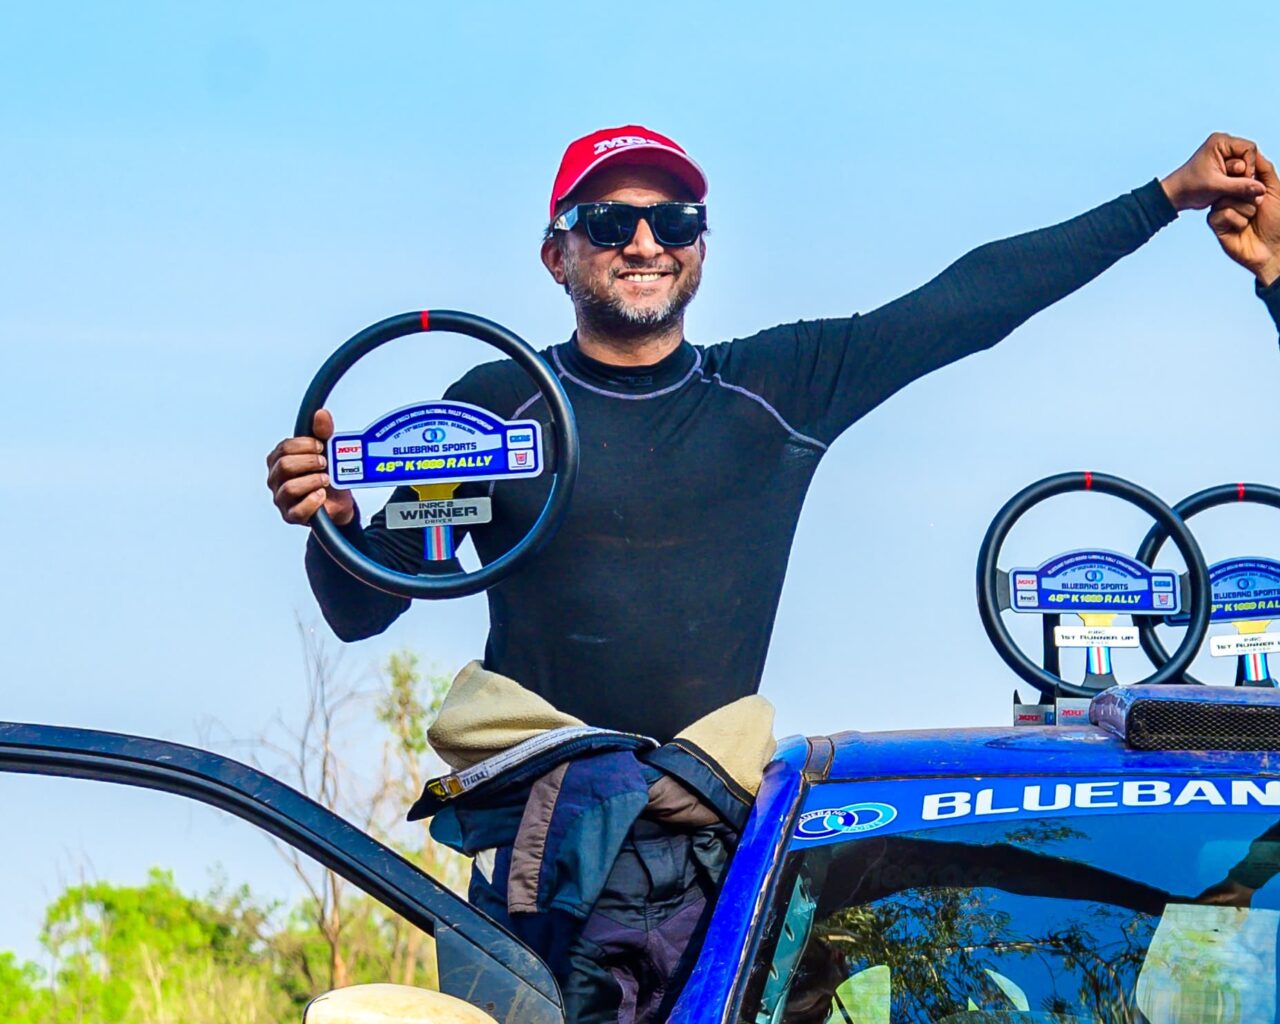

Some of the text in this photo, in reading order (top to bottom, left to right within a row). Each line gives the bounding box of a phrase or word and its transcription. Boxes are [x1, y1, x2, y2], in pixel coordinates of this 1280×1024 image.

[392, 441, 477, 456] BLUEBAND SPORTS
[446, 455, 493, 469] RALLY
[400, 506, 478, 521] WINNER
[1061, 582, 1129, 591] BLUEBAND SPORTS
[1104, 594, 1141, 604] RALLY
[1213, 590, 1251, 600] BLUEBAND
